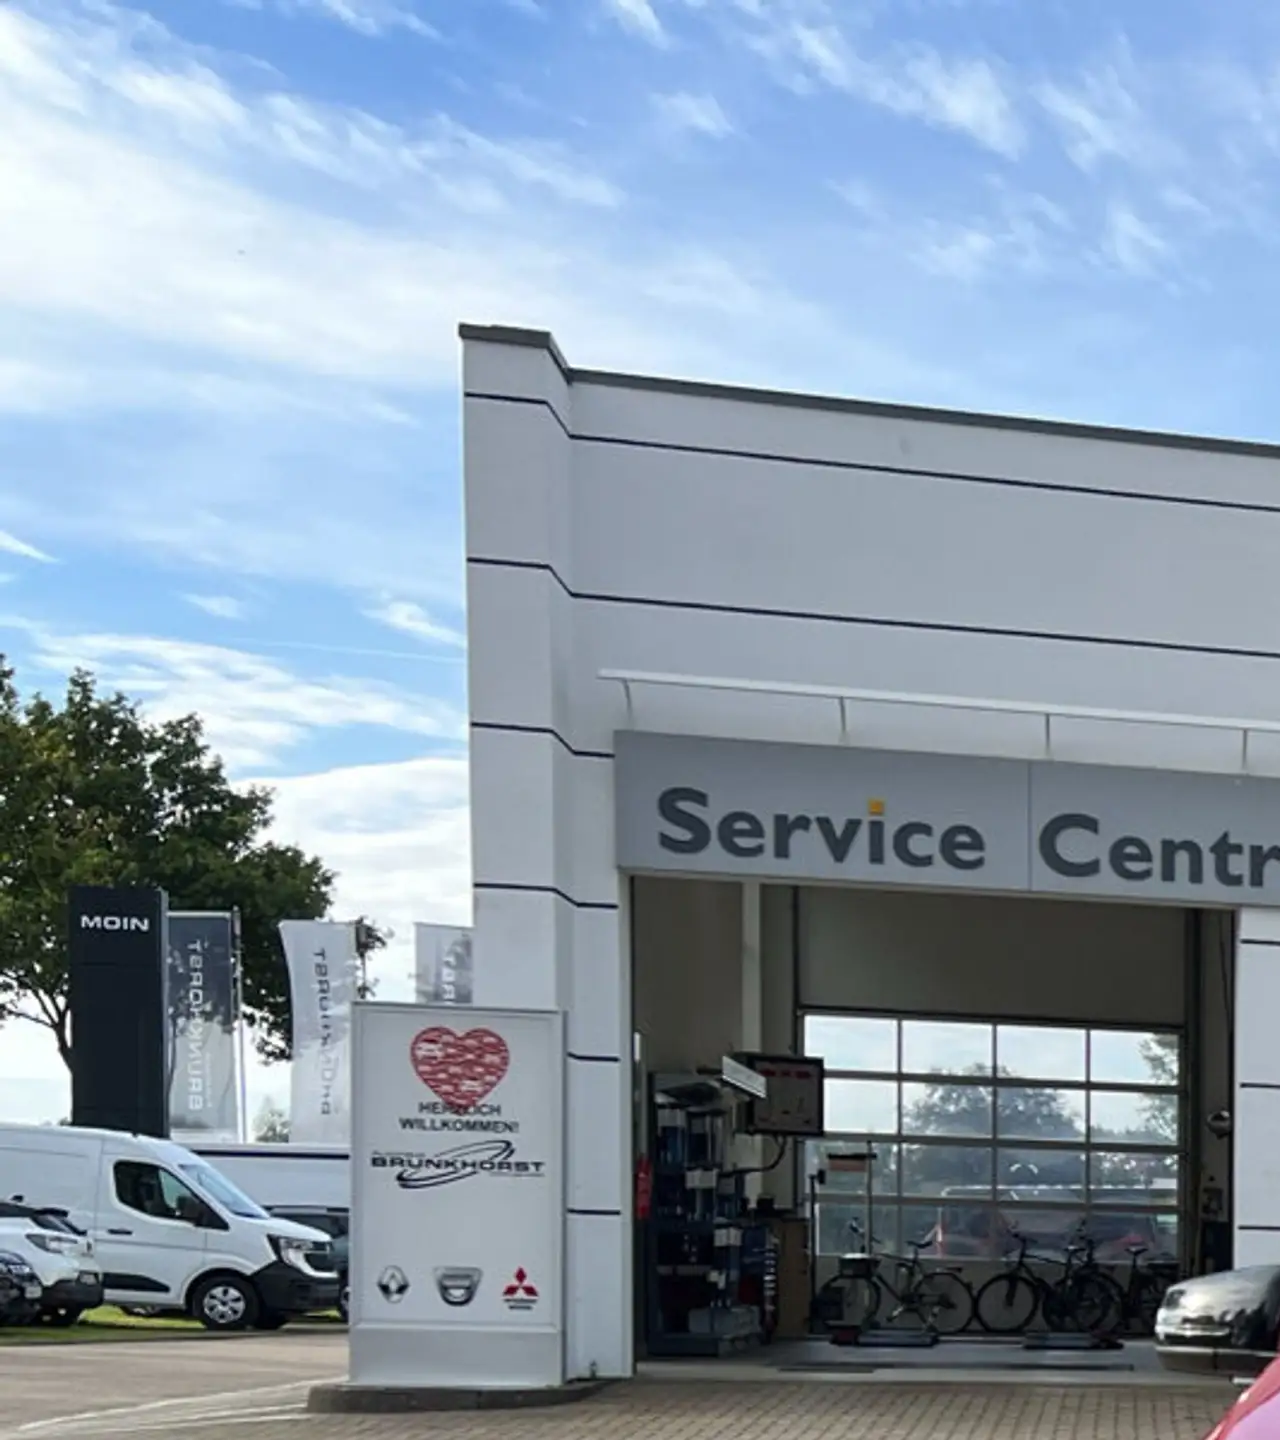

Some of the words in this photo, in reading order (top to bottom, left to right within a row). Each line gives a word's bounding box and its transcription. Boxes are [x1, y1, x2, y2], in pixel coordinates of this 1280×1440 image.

[656, 786, 986, 870] Service
[80, 914, 150, 932] MOIN
[371, 1156, 546, 1173] BRUNKHORST
